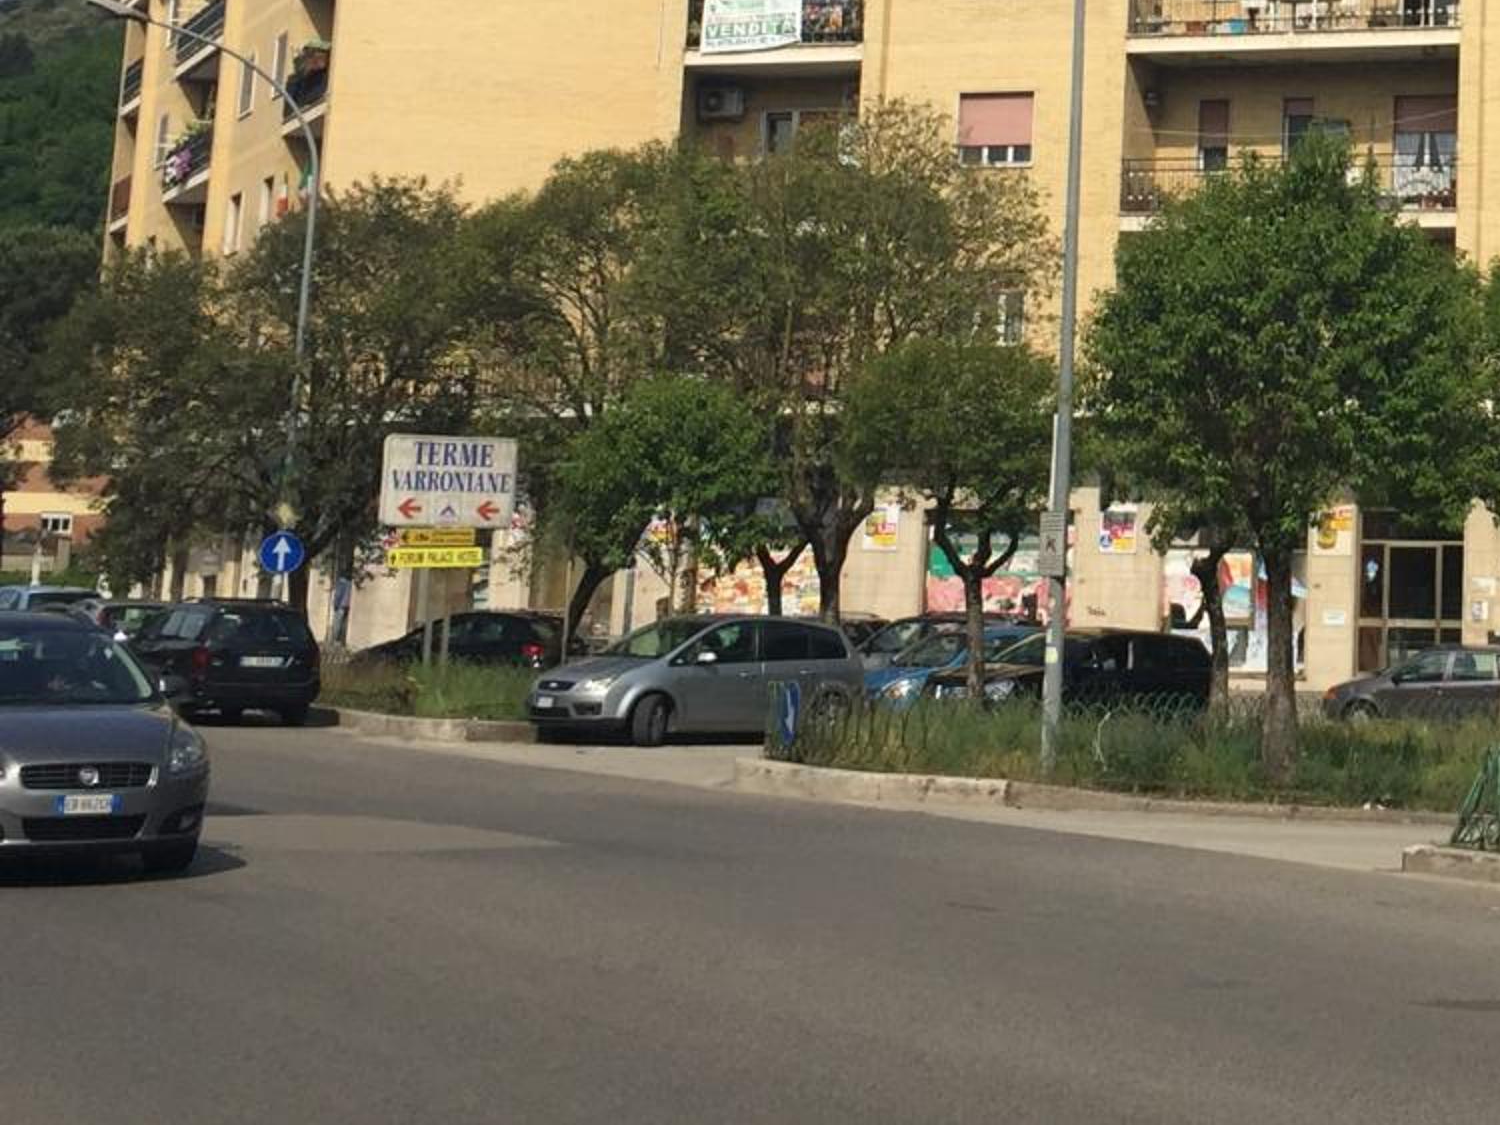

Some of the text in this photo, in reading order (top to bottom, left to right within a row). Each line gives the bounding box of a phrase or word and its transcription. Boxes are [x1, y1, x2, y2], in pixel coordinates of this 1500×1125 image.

[706, 20, 796, 38] VENDITA
[415, 441, 494, 467] TERME
[392, 469, 512, 493] VARRONIANE
